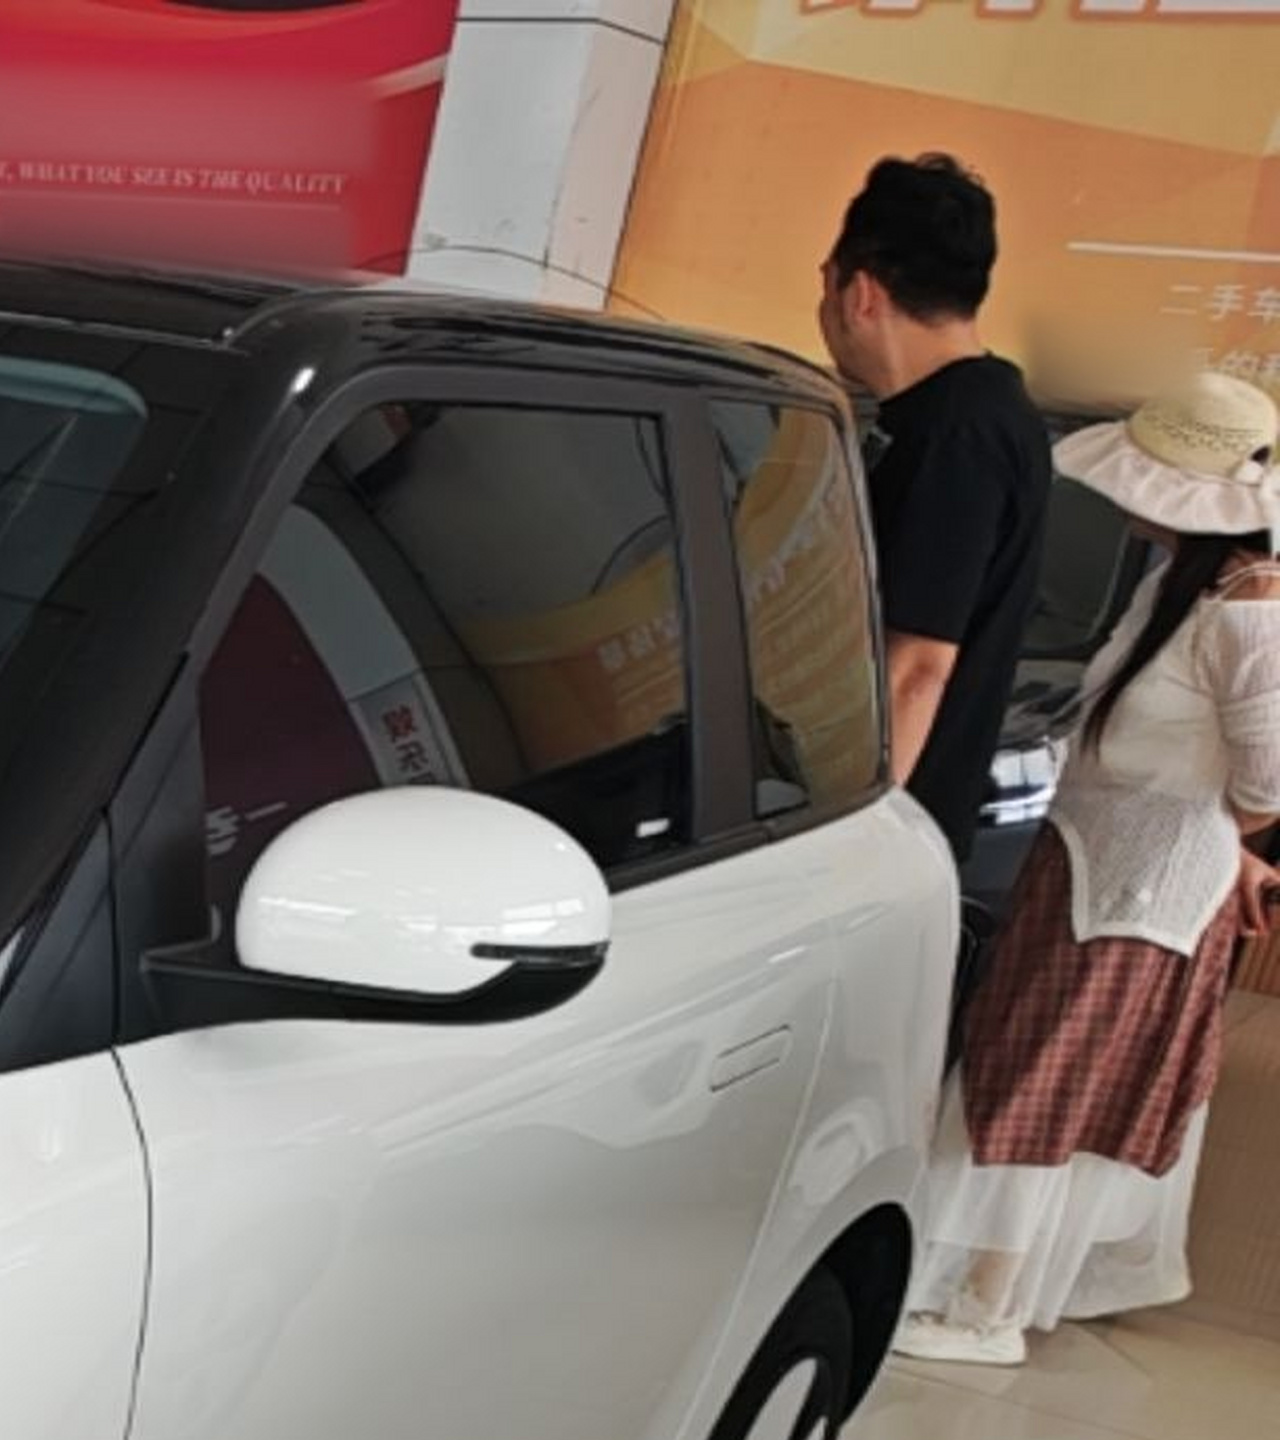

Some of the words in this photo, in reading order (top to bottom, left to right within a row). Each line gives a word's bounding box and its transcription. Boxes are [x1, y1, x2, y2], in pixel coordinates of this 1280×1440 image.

[19, 161, 86, 185] WHAT
[87, 164, 130, 185] YOU
[131, 166, 173, 187] SEE
[196, 168, 243, 190] THE
[244, 170, 345, 195] QUALITY
